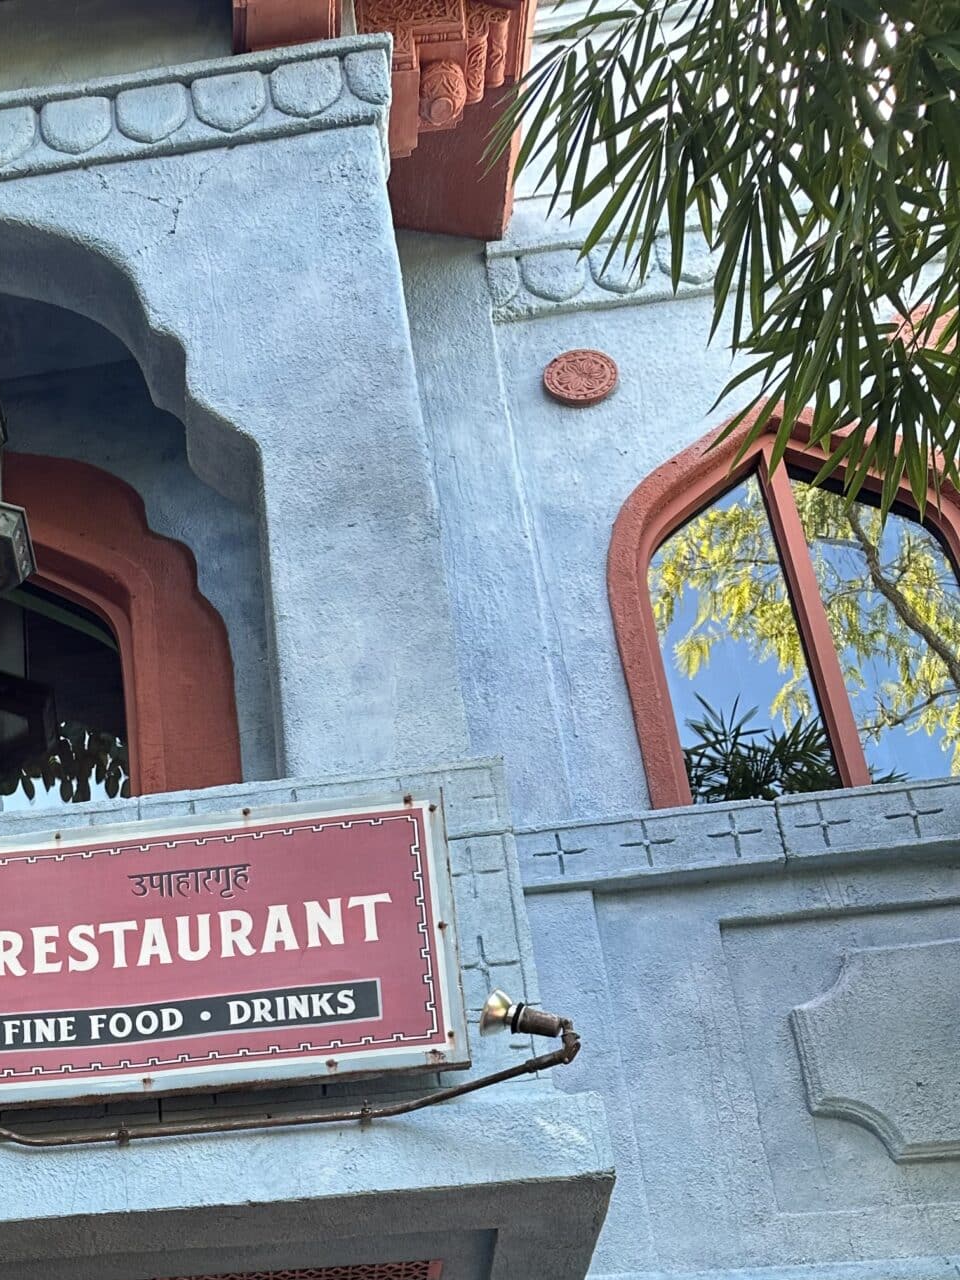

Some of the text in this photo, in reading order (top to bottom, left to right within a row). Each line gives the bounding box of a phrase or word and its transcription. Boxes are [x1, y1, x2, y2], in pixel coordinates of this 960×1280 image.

[128, 863, 251, 898] उपाहारगृह
[3, 1017, 76, 1046] FINE
[90, 1008, 183, 1039] FOOD
[227, 989, 356, 1026] DRINKS
